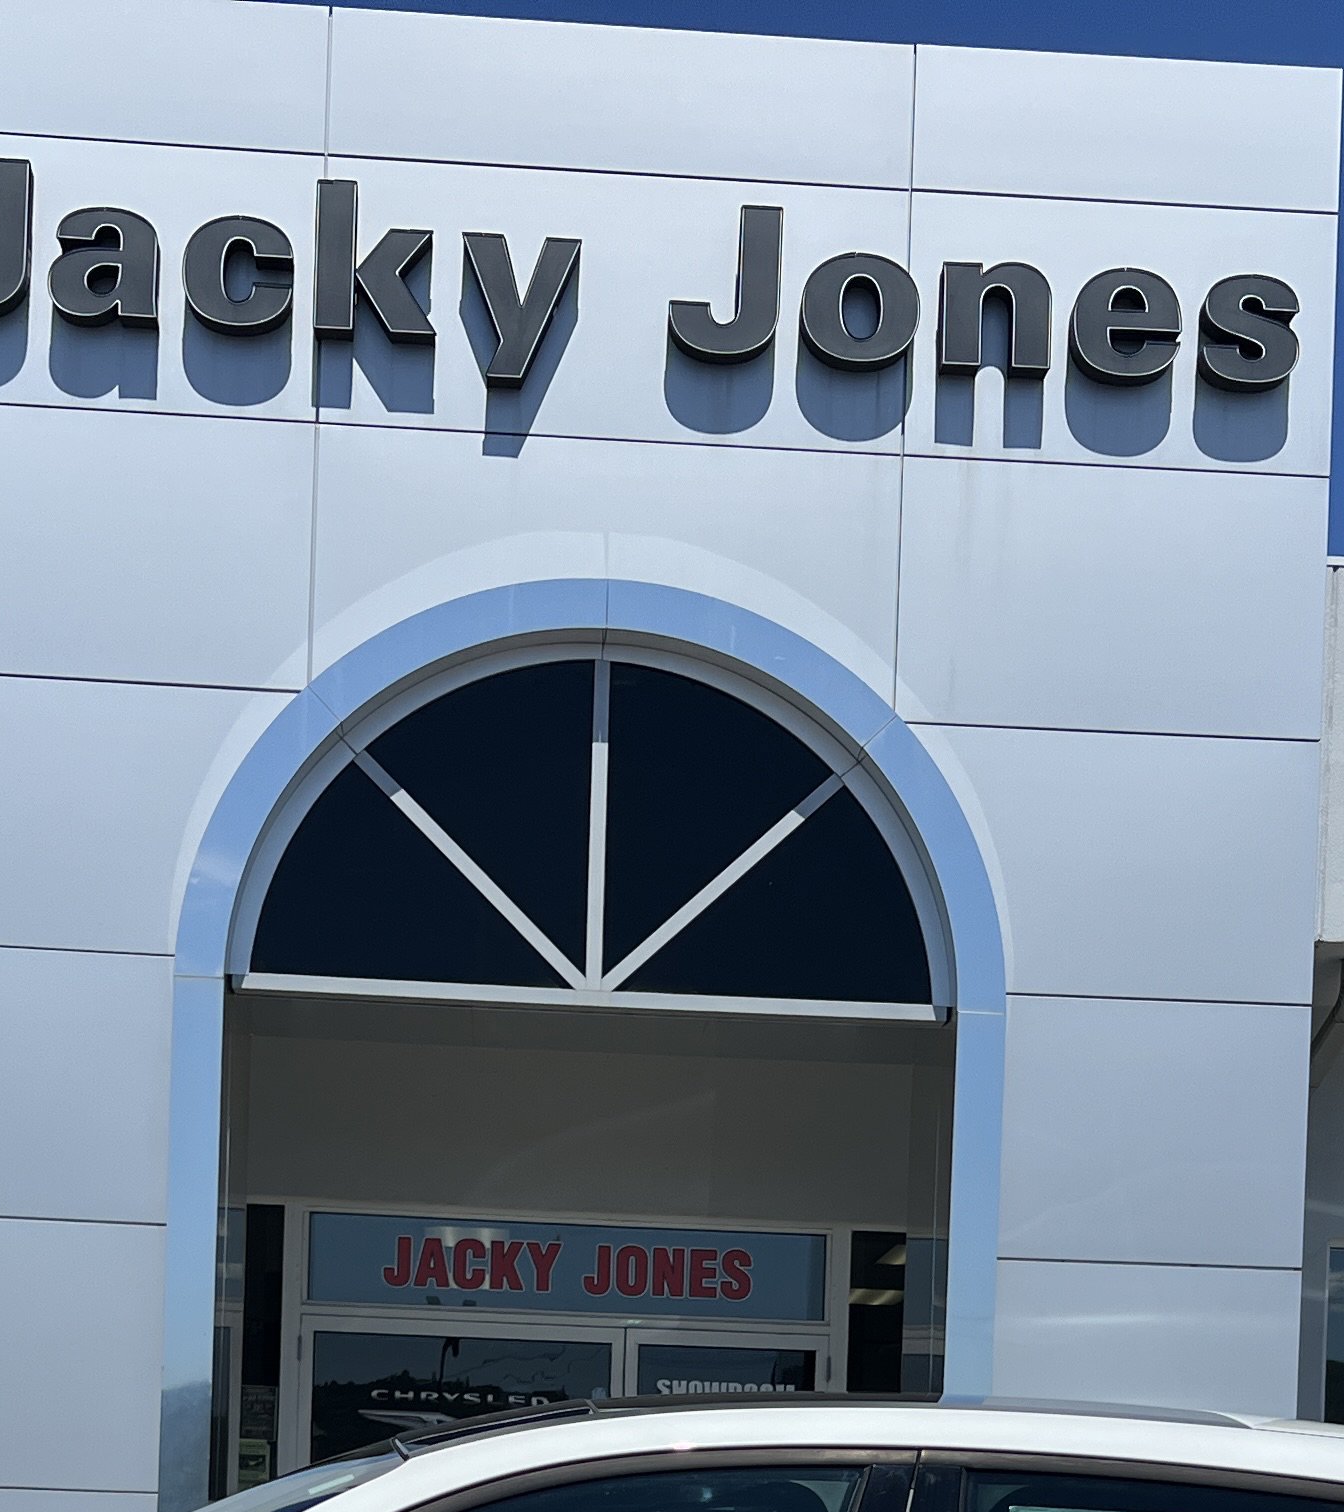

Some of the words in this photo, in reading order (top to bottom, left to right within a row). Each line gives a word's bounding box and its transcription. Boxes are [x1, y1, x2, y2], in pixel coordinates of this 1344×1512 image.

[667, 204, 1300, 392] Jones
[383, 1236, 562, 1293] JACKY
[582, 1244, 753, 1301] JONES
